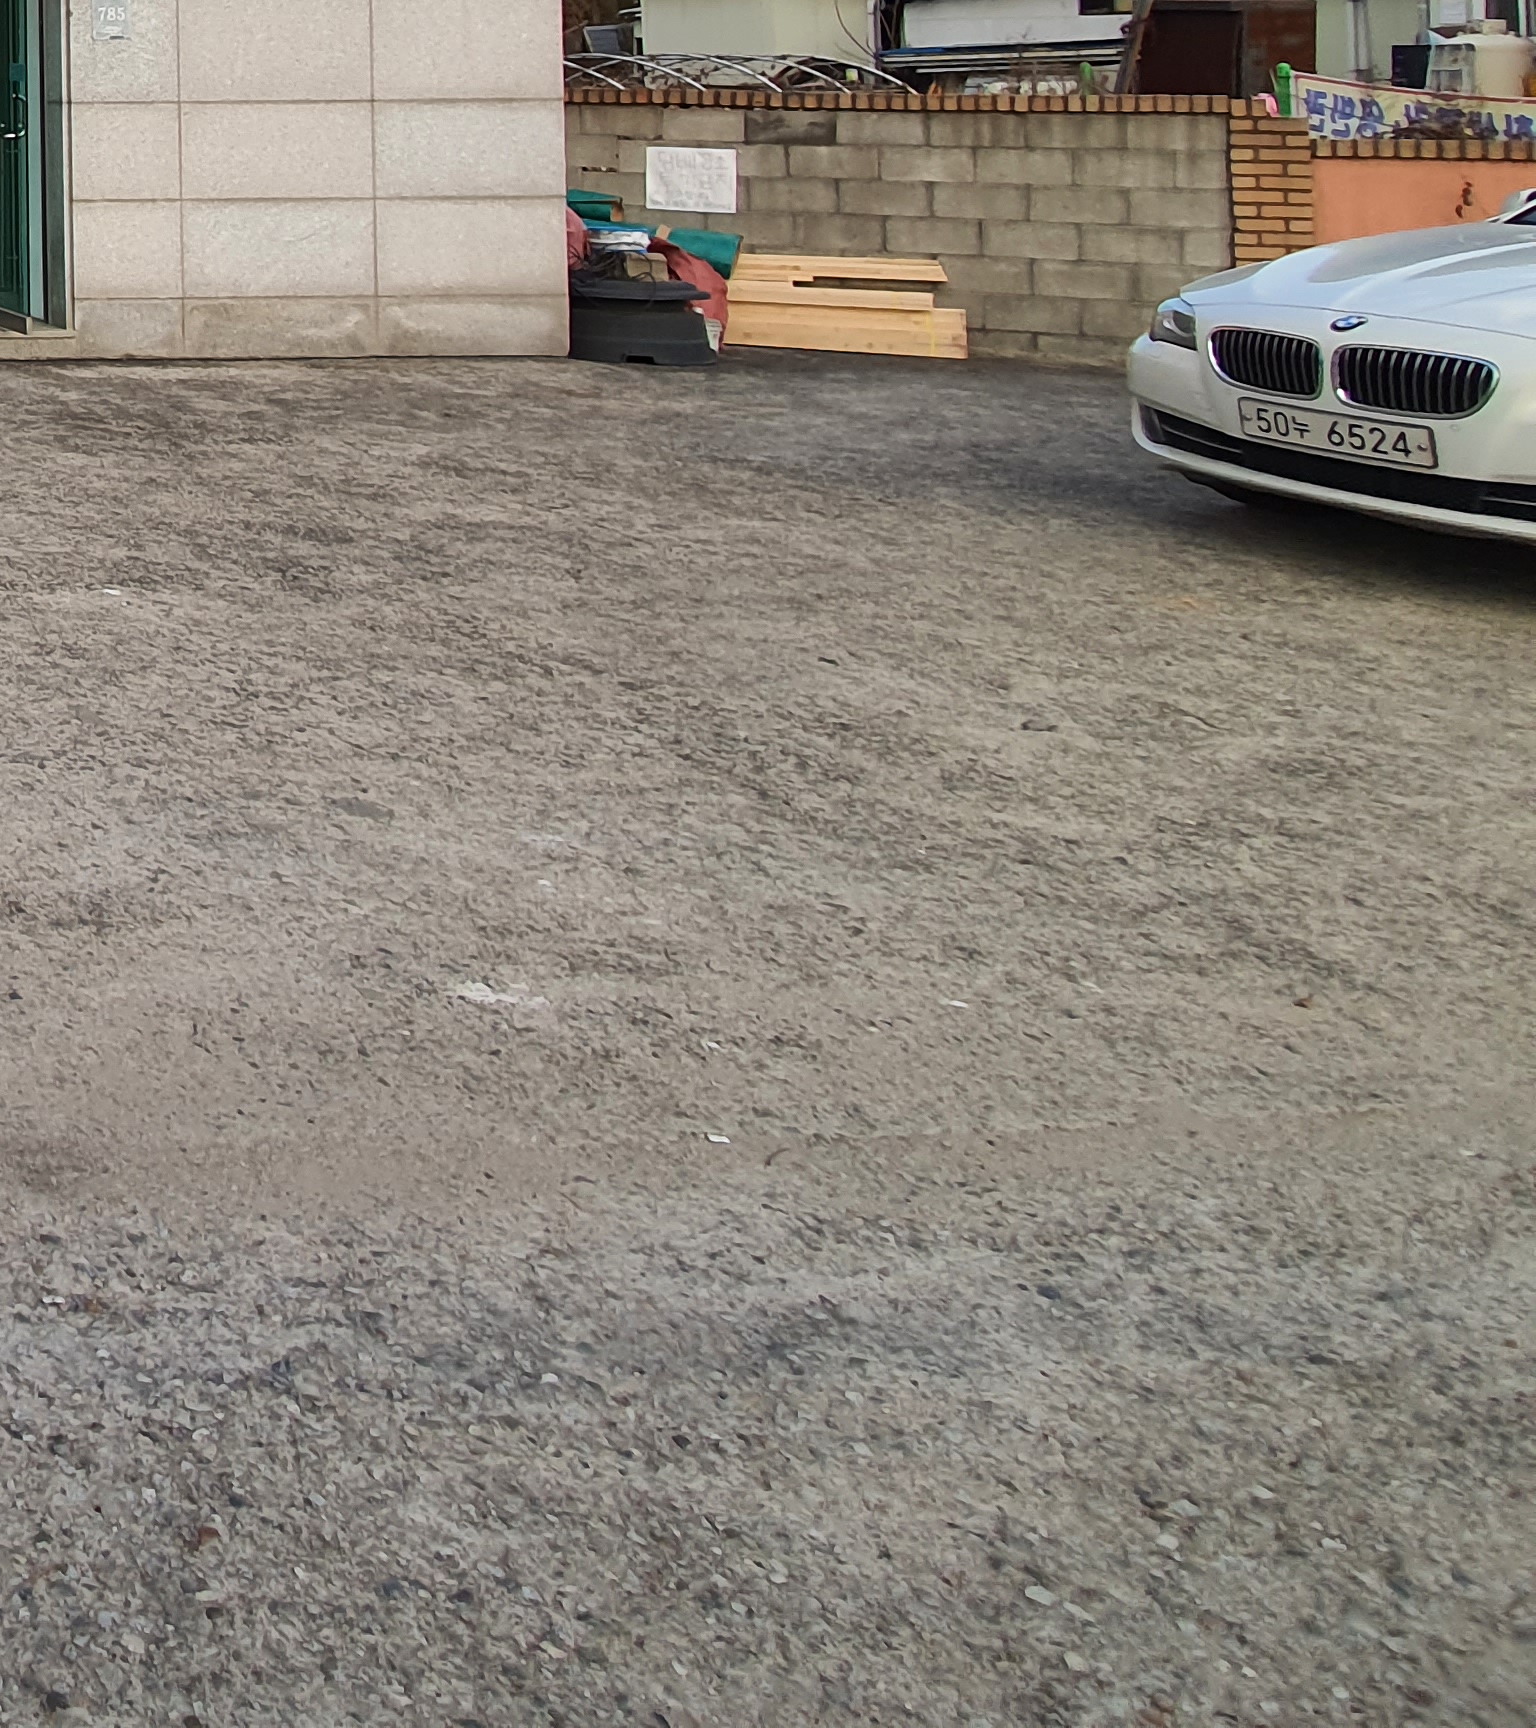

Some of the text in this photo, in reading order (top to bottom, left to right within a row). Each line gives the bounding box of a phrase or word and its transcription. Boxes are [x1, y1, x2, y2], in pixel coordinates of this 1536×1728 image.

[98, 7, 125, 21] 785
[1256, 408, 1414, 458] 50누 6524
